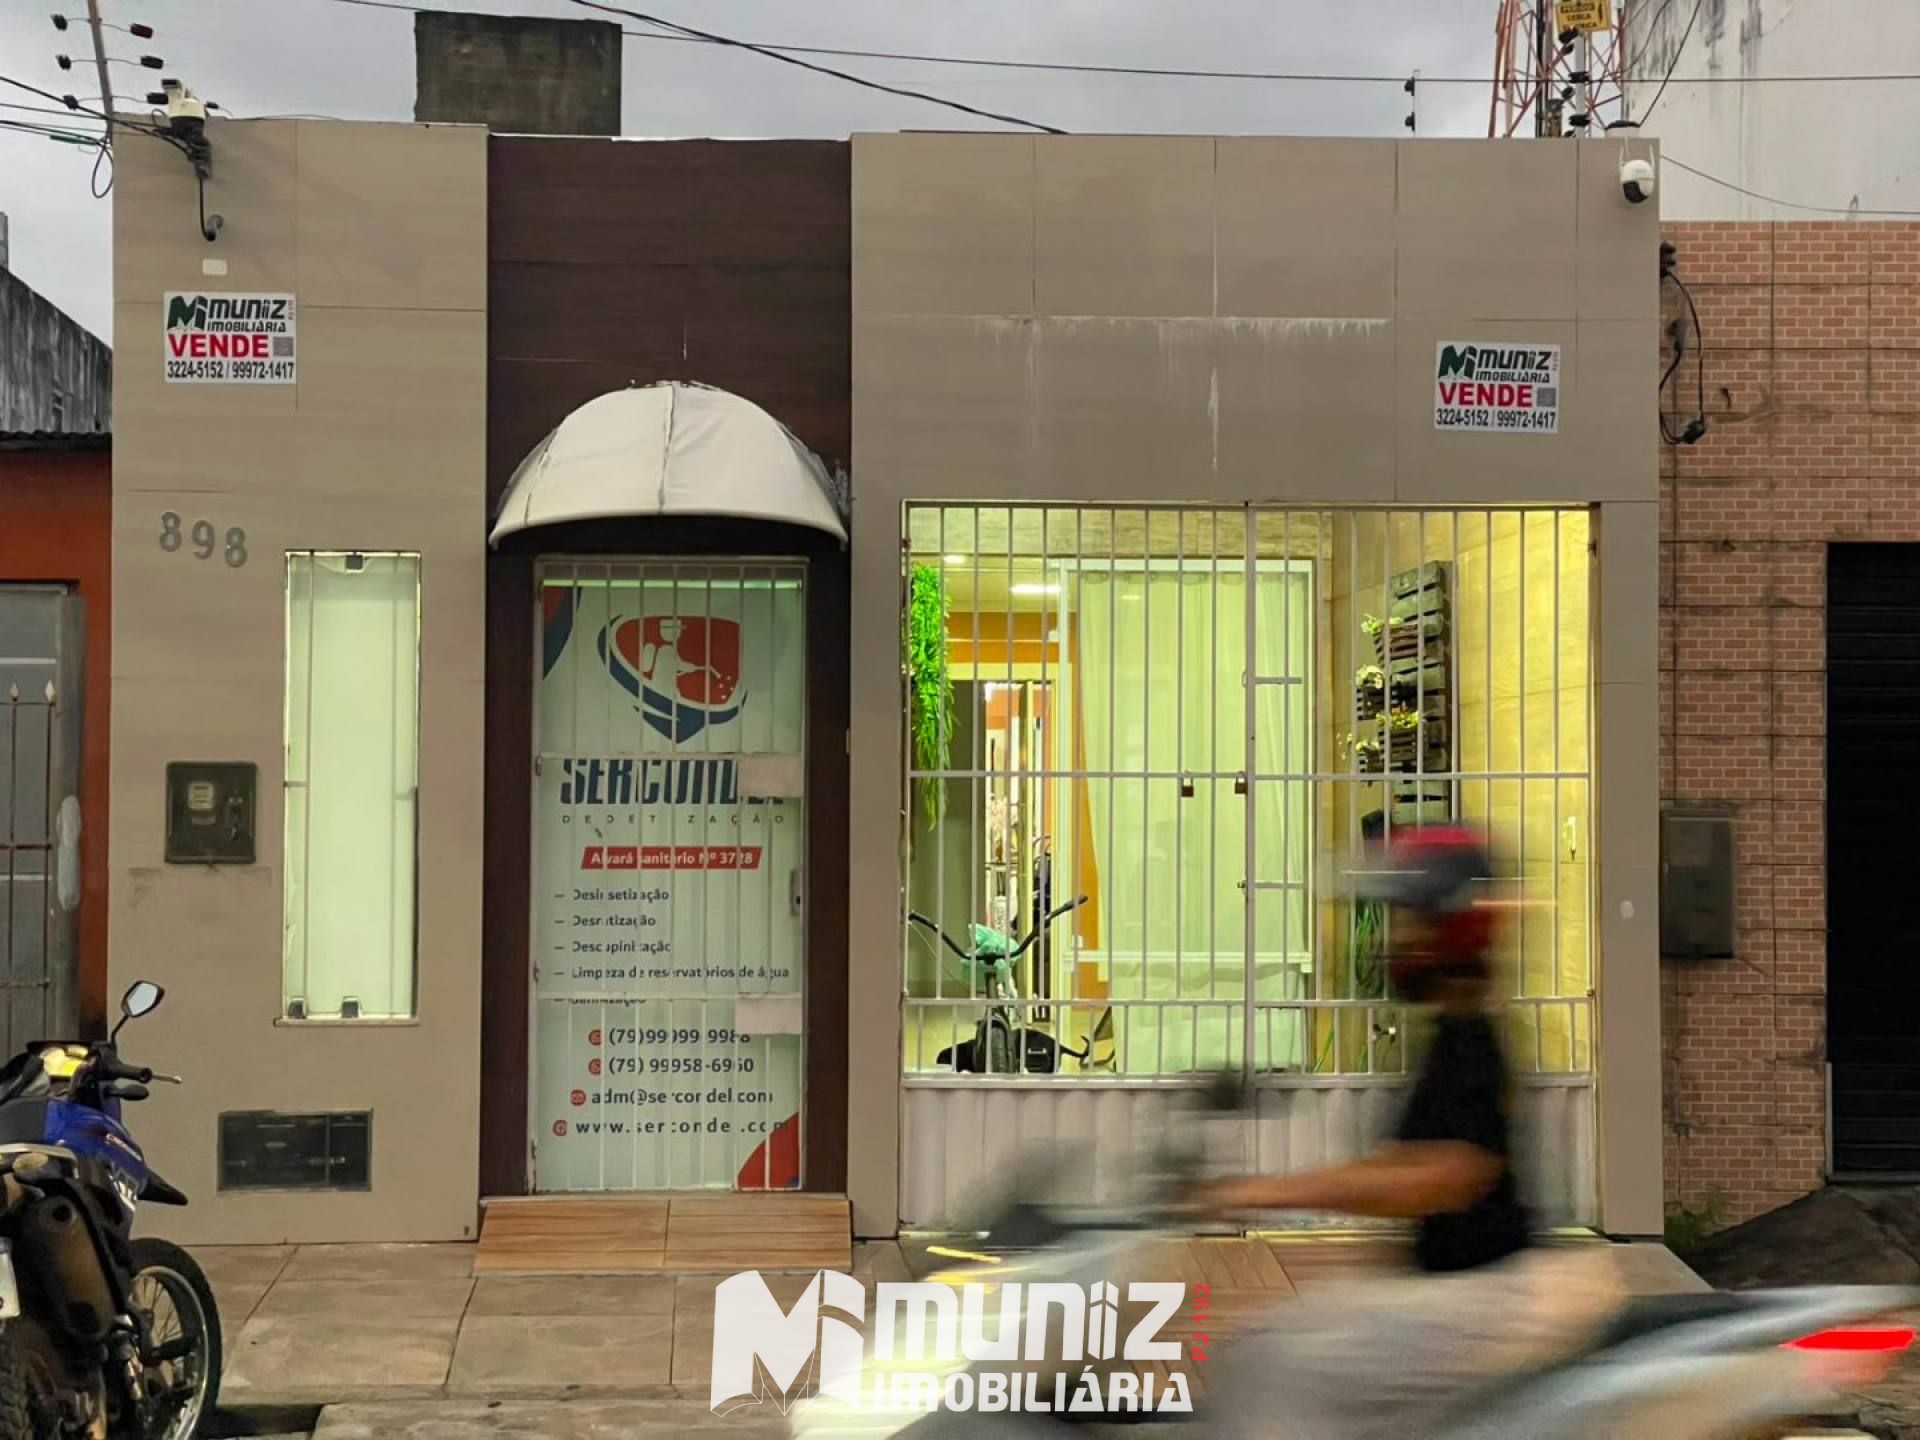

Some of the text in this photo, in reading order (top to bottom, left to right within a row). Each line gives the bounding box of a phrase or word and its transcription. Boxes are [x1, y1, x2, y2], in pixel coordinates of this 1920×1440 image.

[168, 334, 269, 357] VENDE
[167, 361, 223, 379] 3224-5152
[233, 362, 294, 379] 99972-1417
[1439, 382, 1533, 407] VENDE
[1436, 408, 1489, 427] 3224-5152
[1497, 410, 1556, 429] 99972-1417
[159, 511, 249, 568] 898
[738, 966, 754, 978] de
